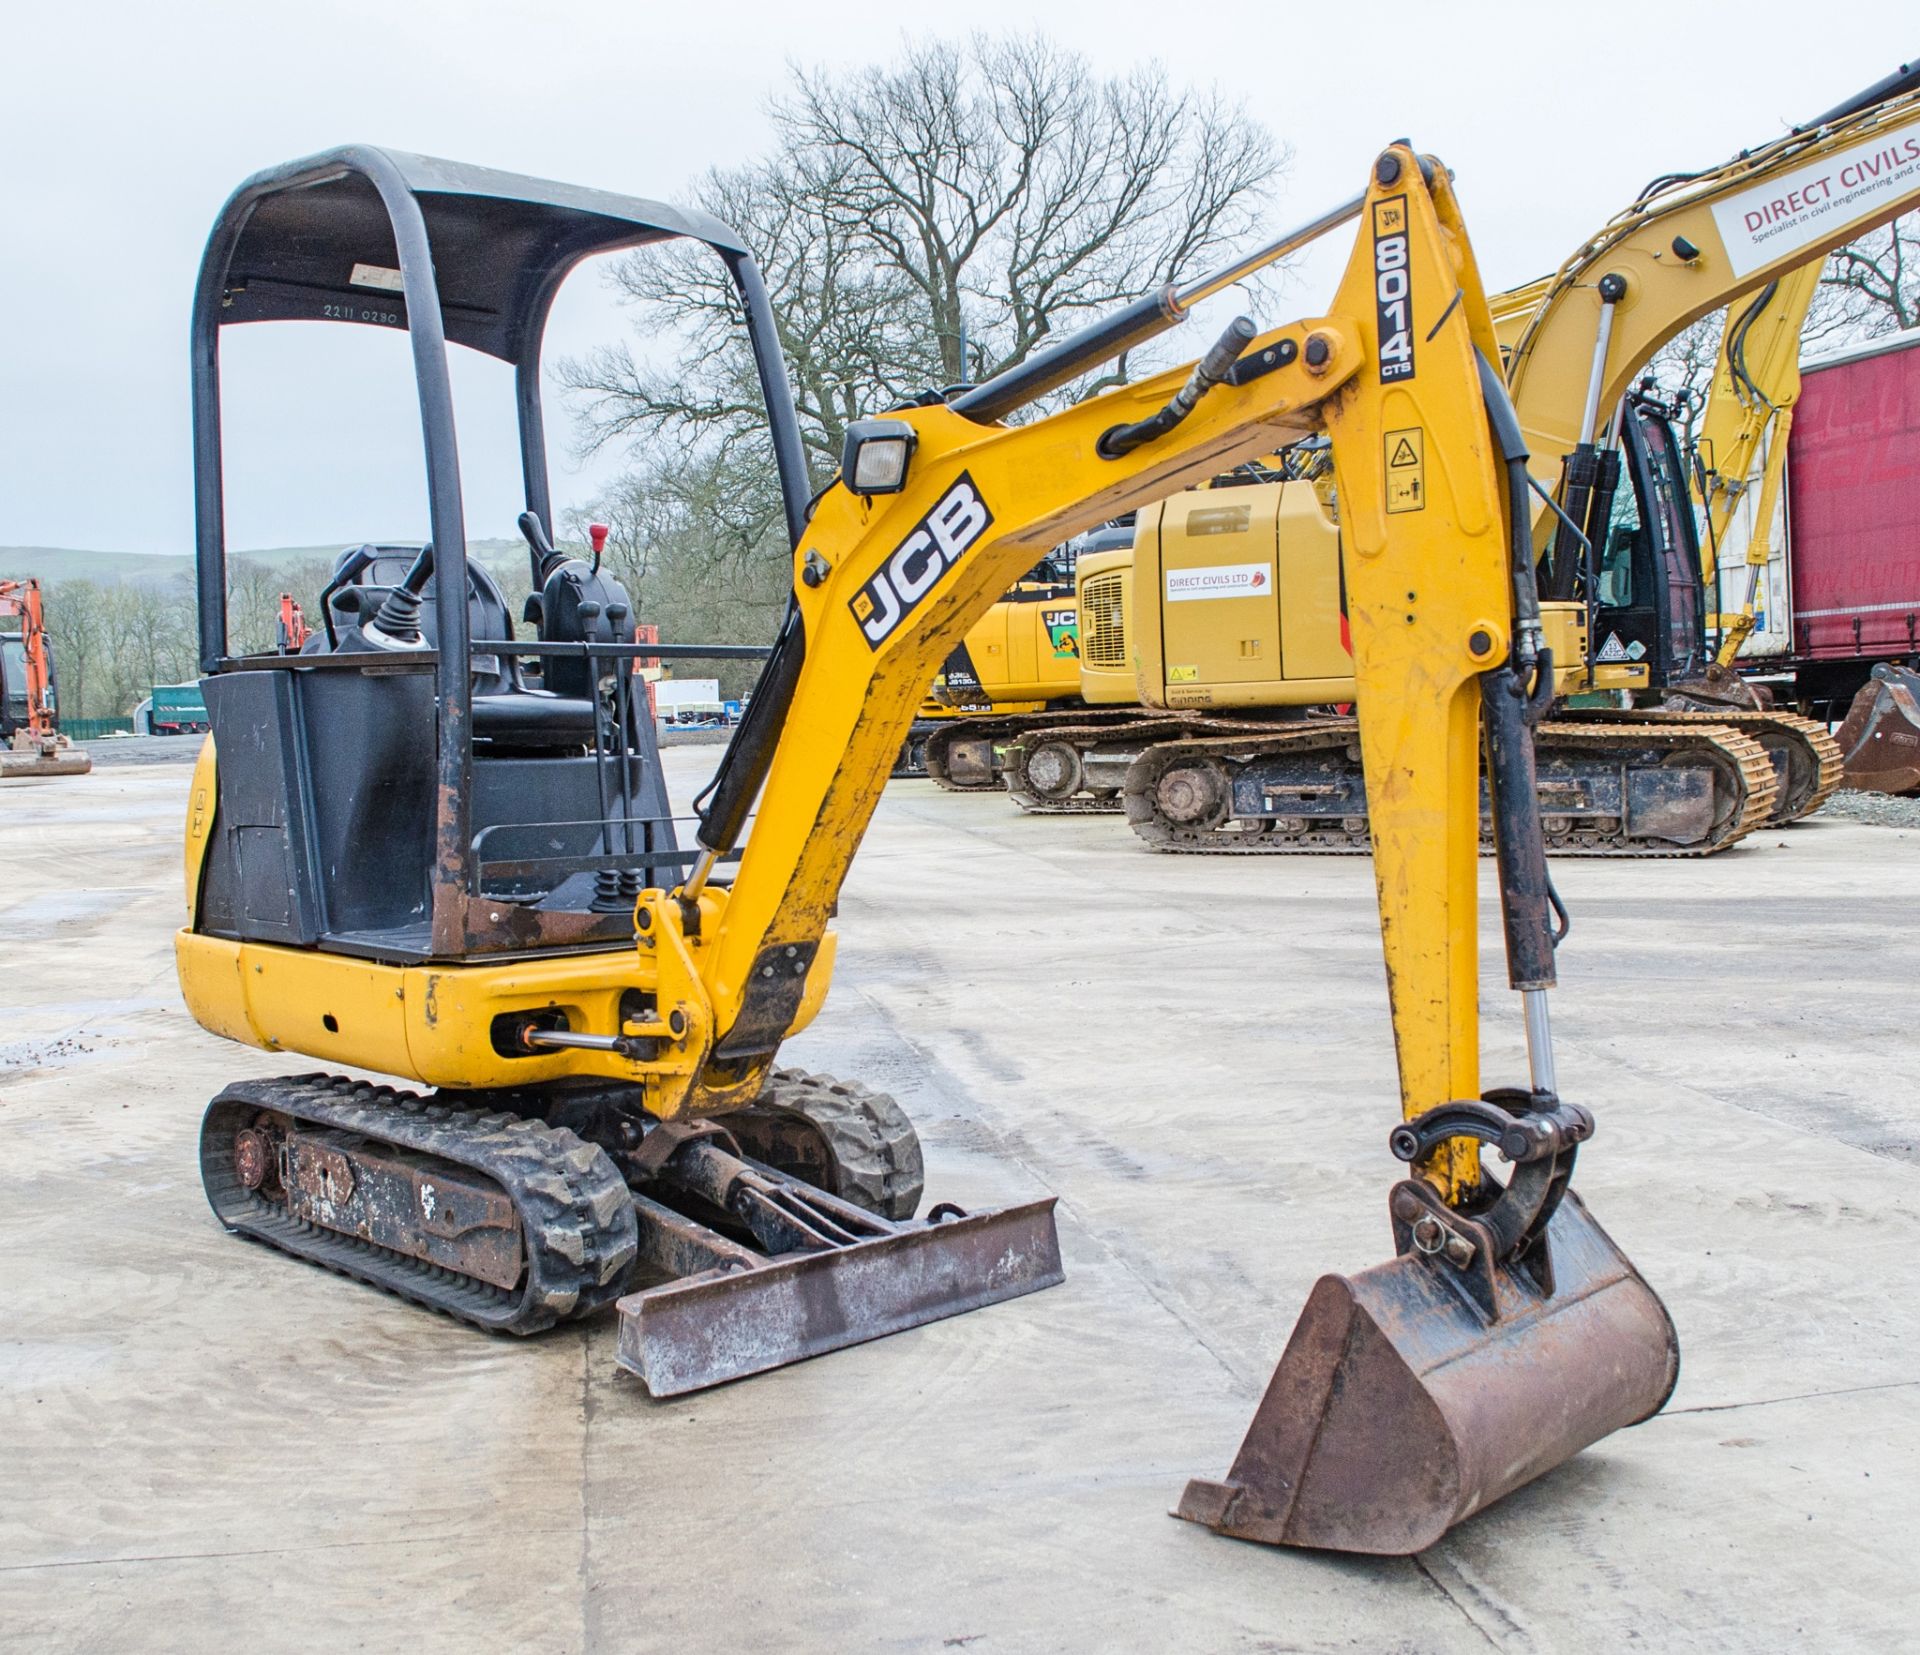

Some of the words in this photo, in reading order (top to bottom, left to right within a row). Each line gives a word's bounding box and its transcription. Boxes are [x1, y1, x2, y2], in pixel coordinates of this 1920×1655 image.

[1744, 176, 1831, 233] DIRECT
[1840, 138, 1920, 188] CIVILS
[1752, 218, 1798, 244] Specialist
[1799, 214, 1809, 223] in
[1811, 204, 1832, 218] civil
[1832, 176, 1893, 208] engineering
[1895, 163, 1914, 180] and
[323, 304, 354, 319] 2211
[1376, 236, 1412, 362] 8014
[1382, 361, 1412, 377] CTS
[864, 483, 987, 641] JCB
[1169, 576, 1200, 588] DIRECT
[1202, 574, 1230, 586] CIVILS
[1232, 573, 1249, 583] LTD
[1046, 611, 1078, 626] JC
